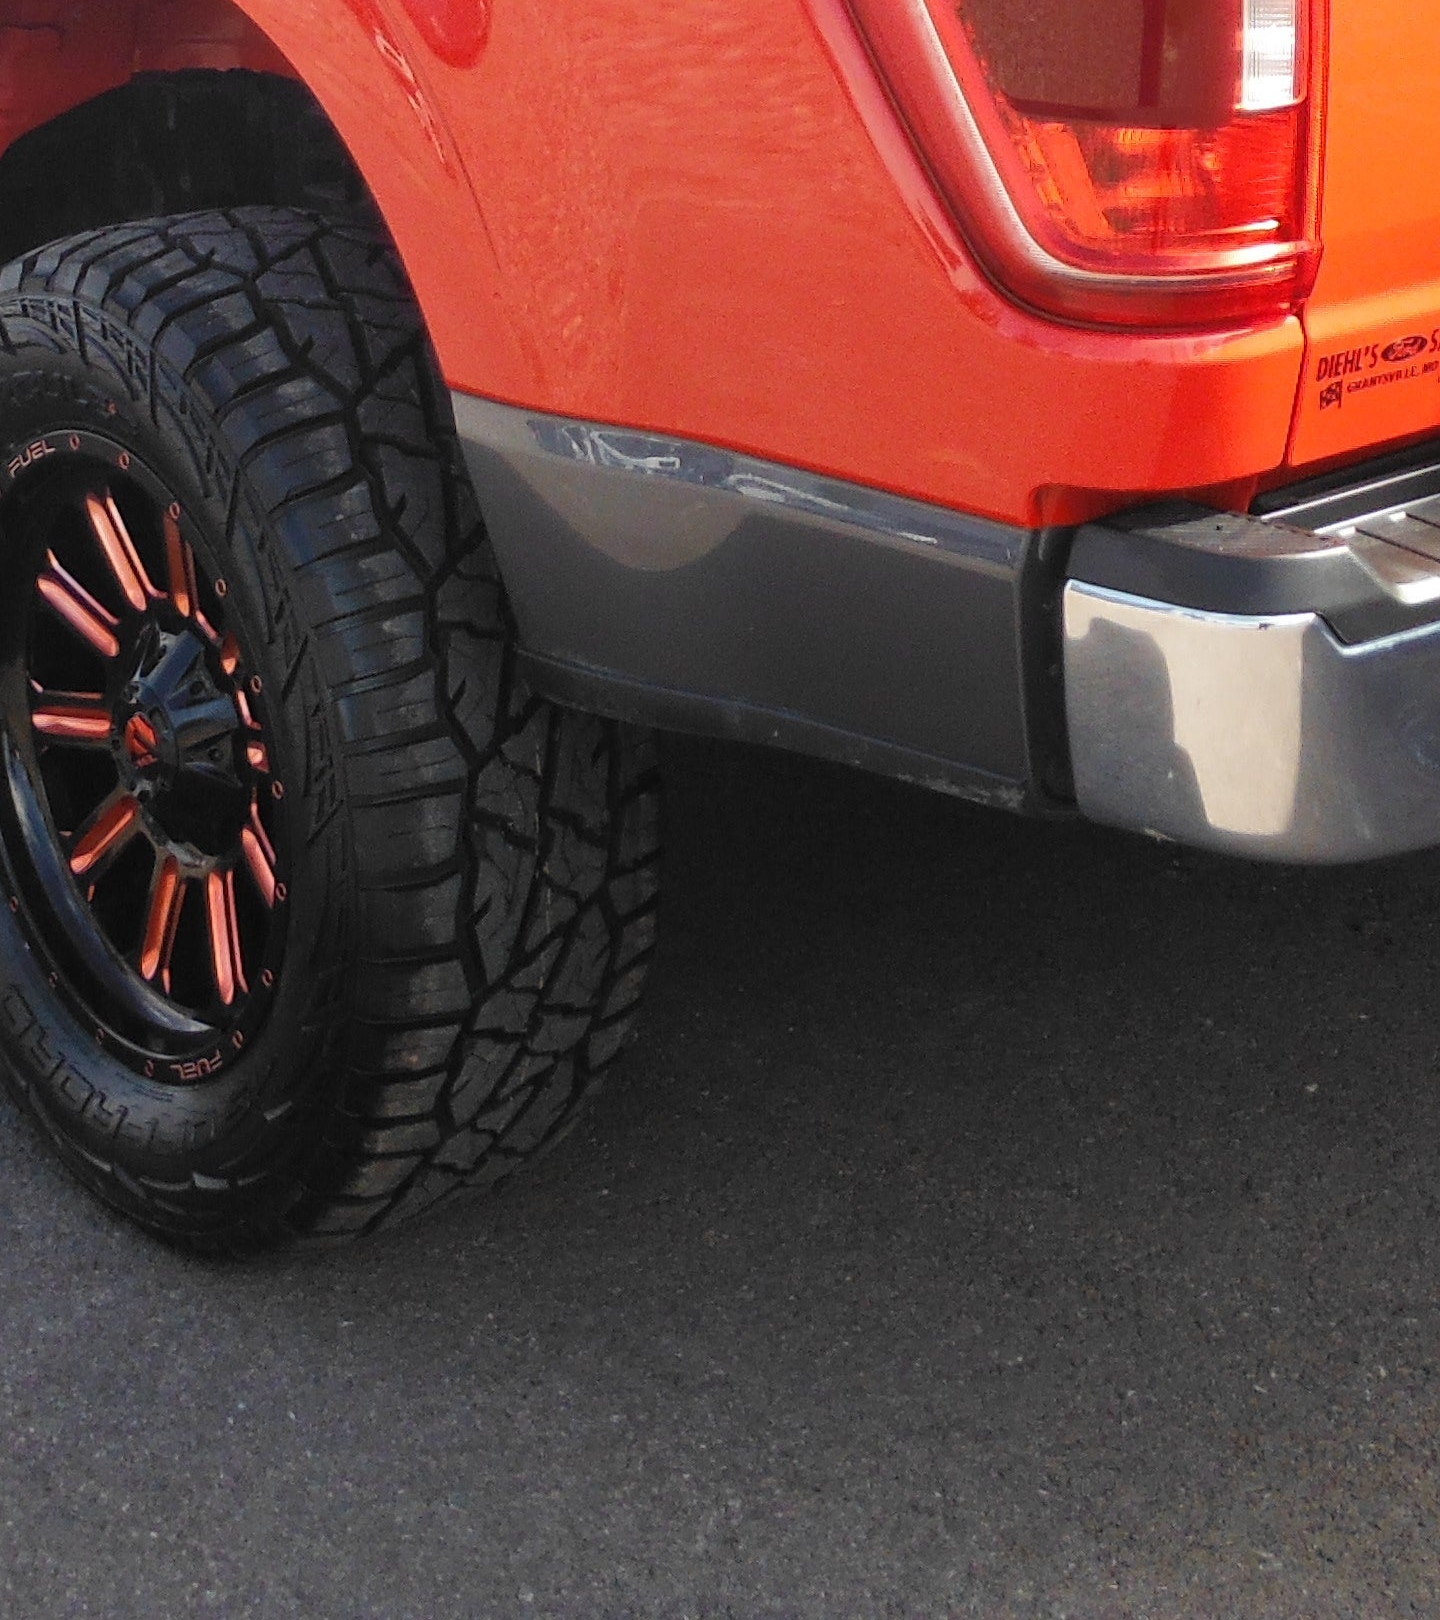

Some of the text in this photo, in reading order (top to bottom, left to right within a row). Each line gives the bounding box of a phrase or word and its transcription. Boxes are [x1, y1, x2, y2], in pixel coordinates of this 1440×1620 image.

[1316, 344, 1379, 382] DIEHL'S
[7, 439, 56, 479] FUEL
[169, 1049, 223, 1081] FUEL
